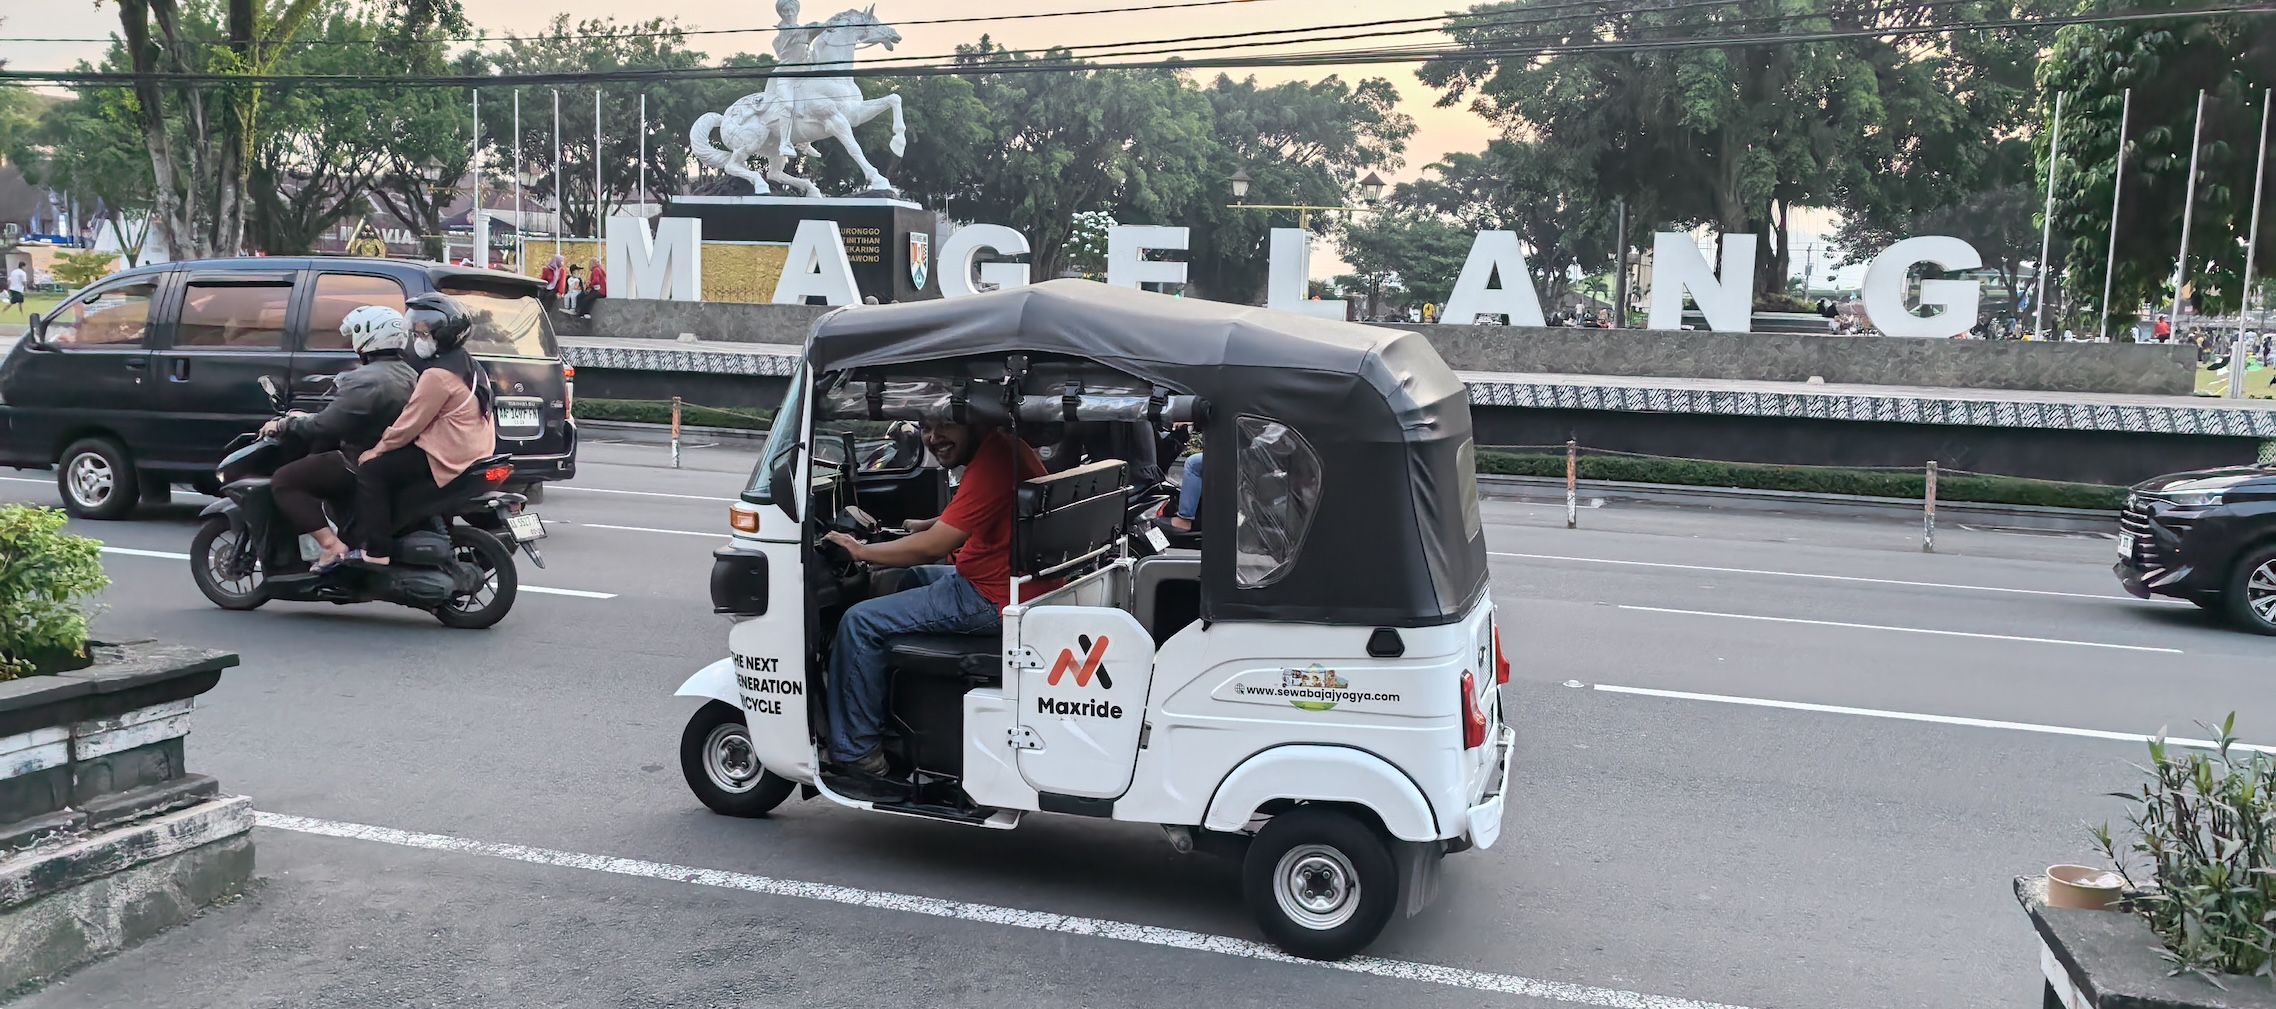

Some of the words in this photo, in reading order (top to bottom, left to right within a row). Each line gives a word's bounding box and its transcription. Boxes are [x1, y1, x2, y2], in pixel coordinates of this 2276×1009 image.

[840, 227, 881, 235] URONGGO
[845, 245, 880, 254] EKARING
[606, 216, 1982, 338] MAGELANG
[746, 656, 779, 673] NEXT
[1246, 686, 1400, 702] www.sewabajajyogya.com
[1037, 696, 1123, 719] Maxride
